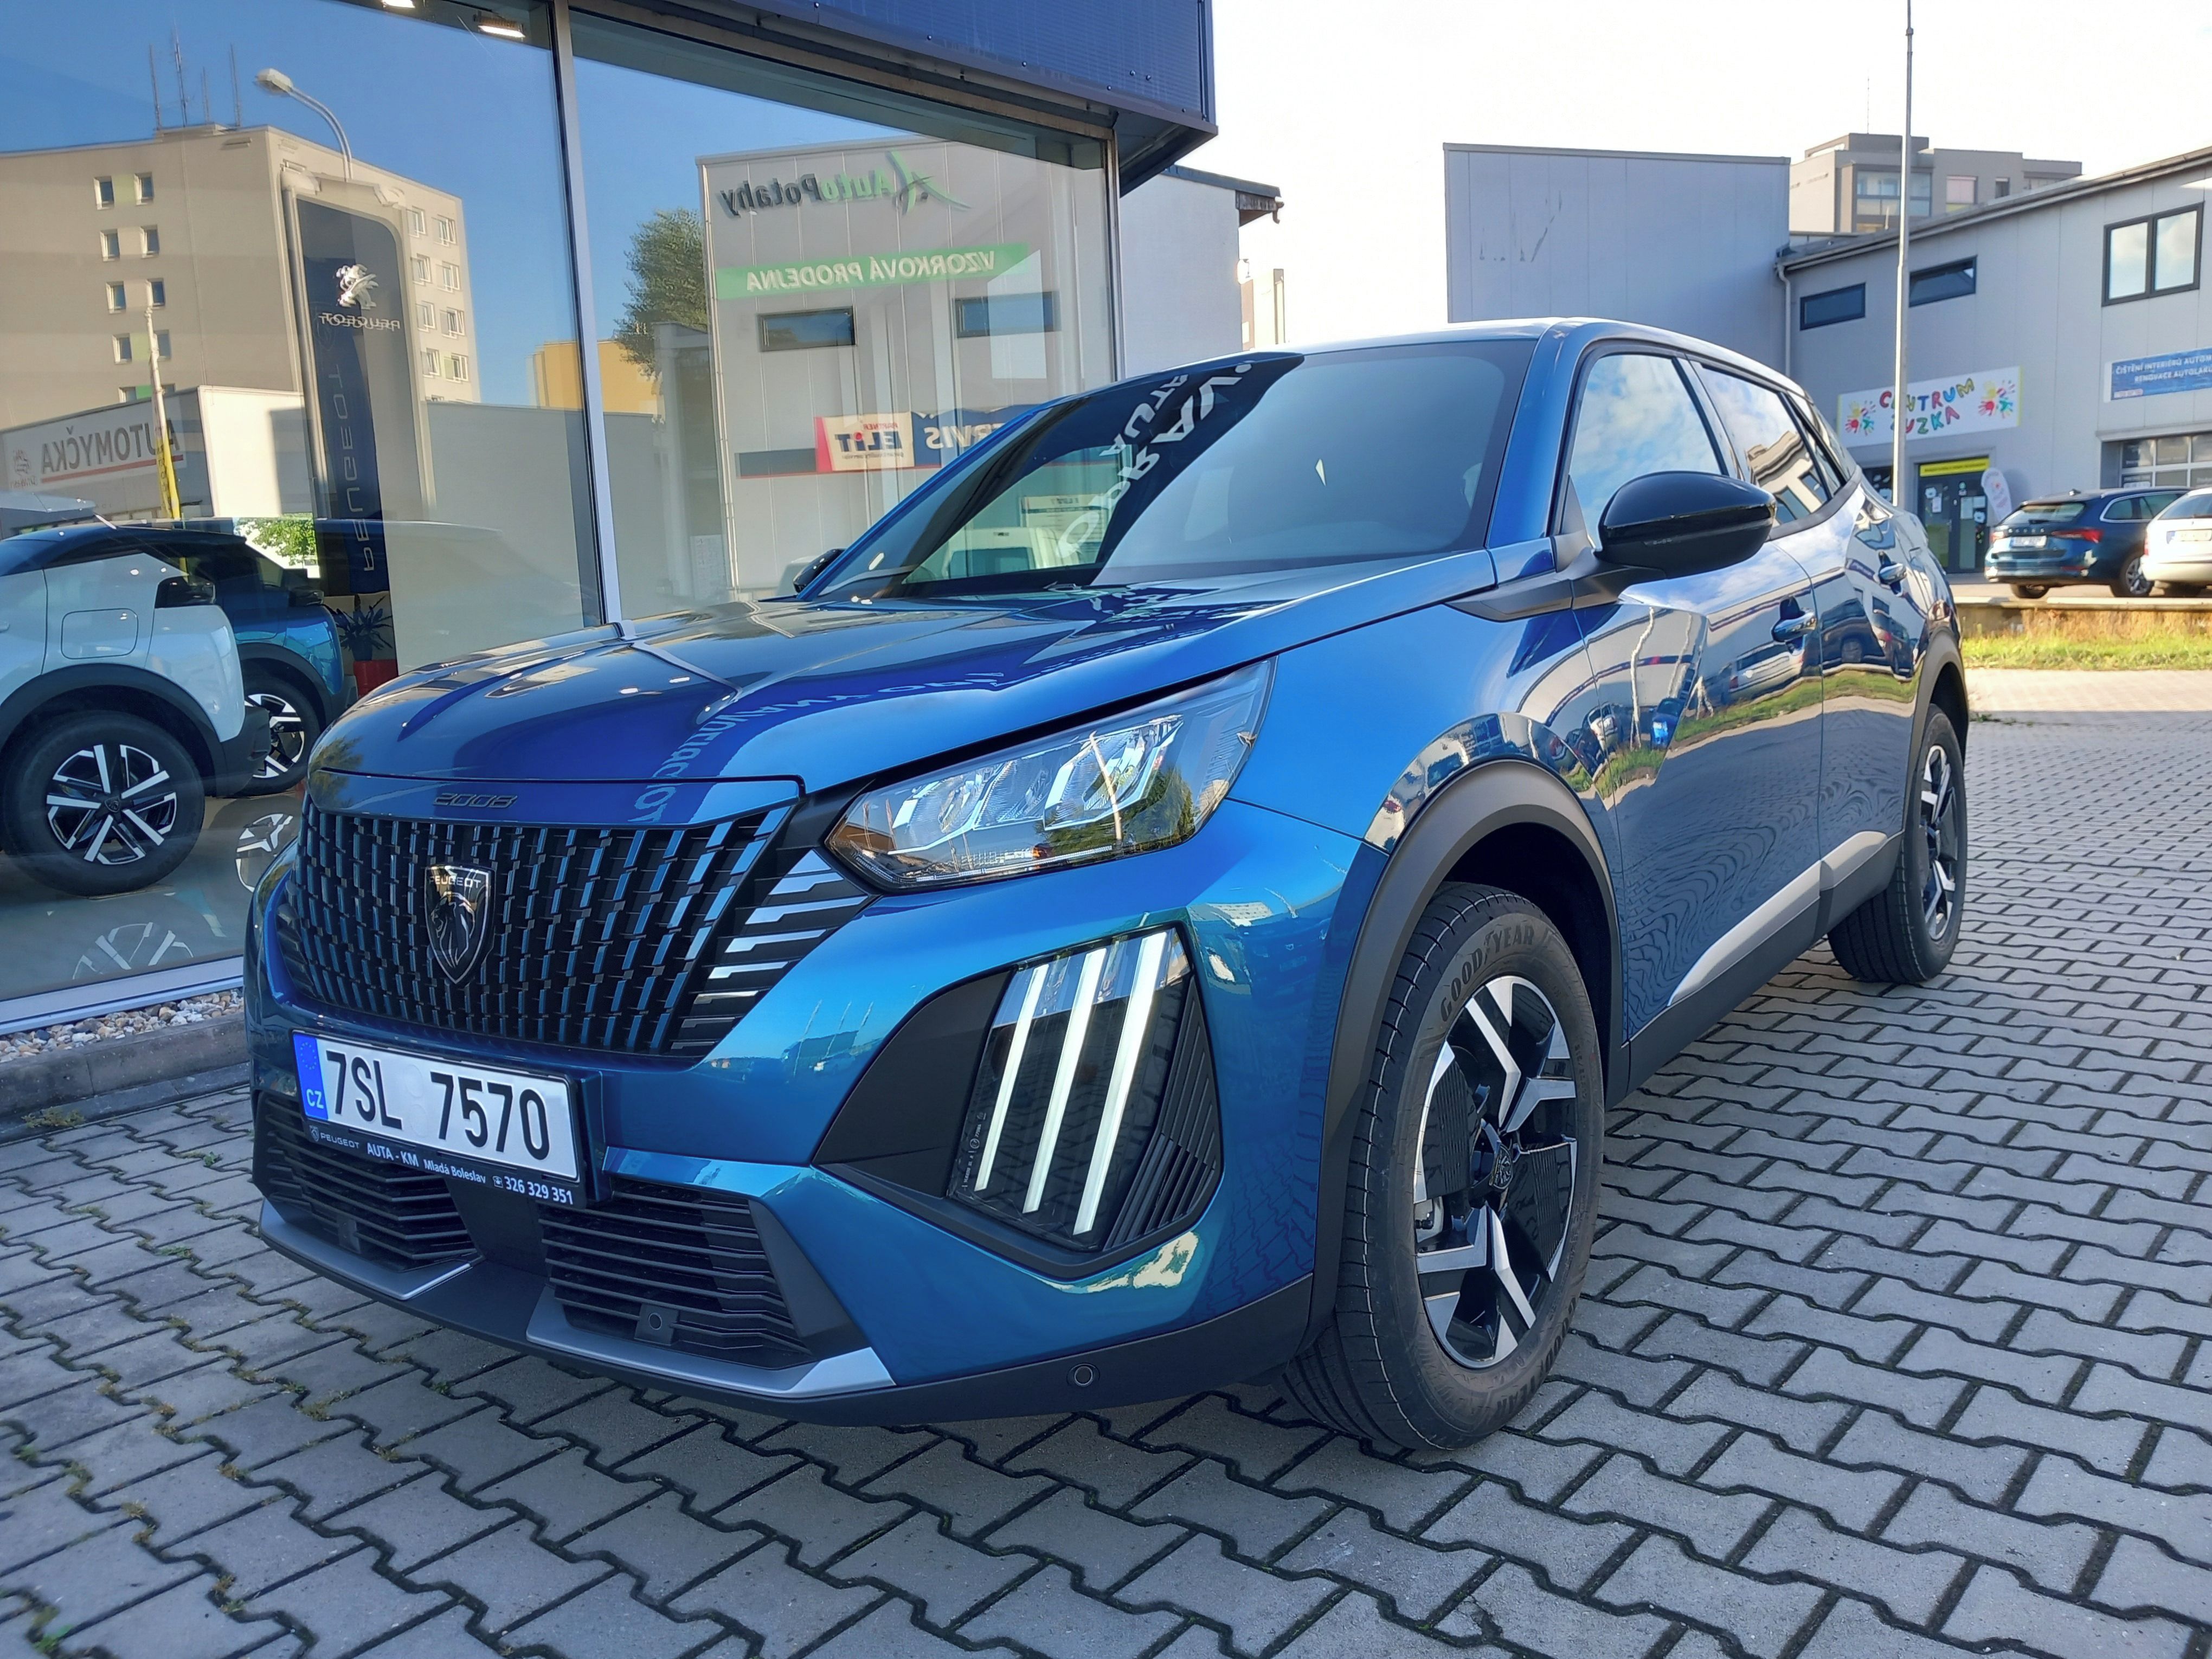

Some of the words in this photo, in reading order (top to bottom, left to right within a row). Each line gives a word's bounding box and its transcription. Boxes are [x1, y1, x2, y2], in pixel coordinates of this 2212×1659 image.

[1879, 378, 1975, 412] CNTRUM
[1891, 406, 1960, 434] UZKA
[434, 793, 518, 808] 2008
[429, 875, 481, 888] PEUGEOT
[306, 1088, 324, 1109] CZ
[326, 1050, 402, 1130] 7SL
[430, 1071, 550, 1160] 7570
[320, 1132, 359, 1149] PEUGEOT
[366, 1142, 394, 1161] AUTA
[400, 1151, 419, 1167] KM
[423, 1159, 450, 1175] Mladá
[451, 1166, 486, 1184] Boleslav
[504, 1176, 525, 1193] 326
[527, 1181, 549, 1199] 329
[551, 1186, 574, 1205] 351
